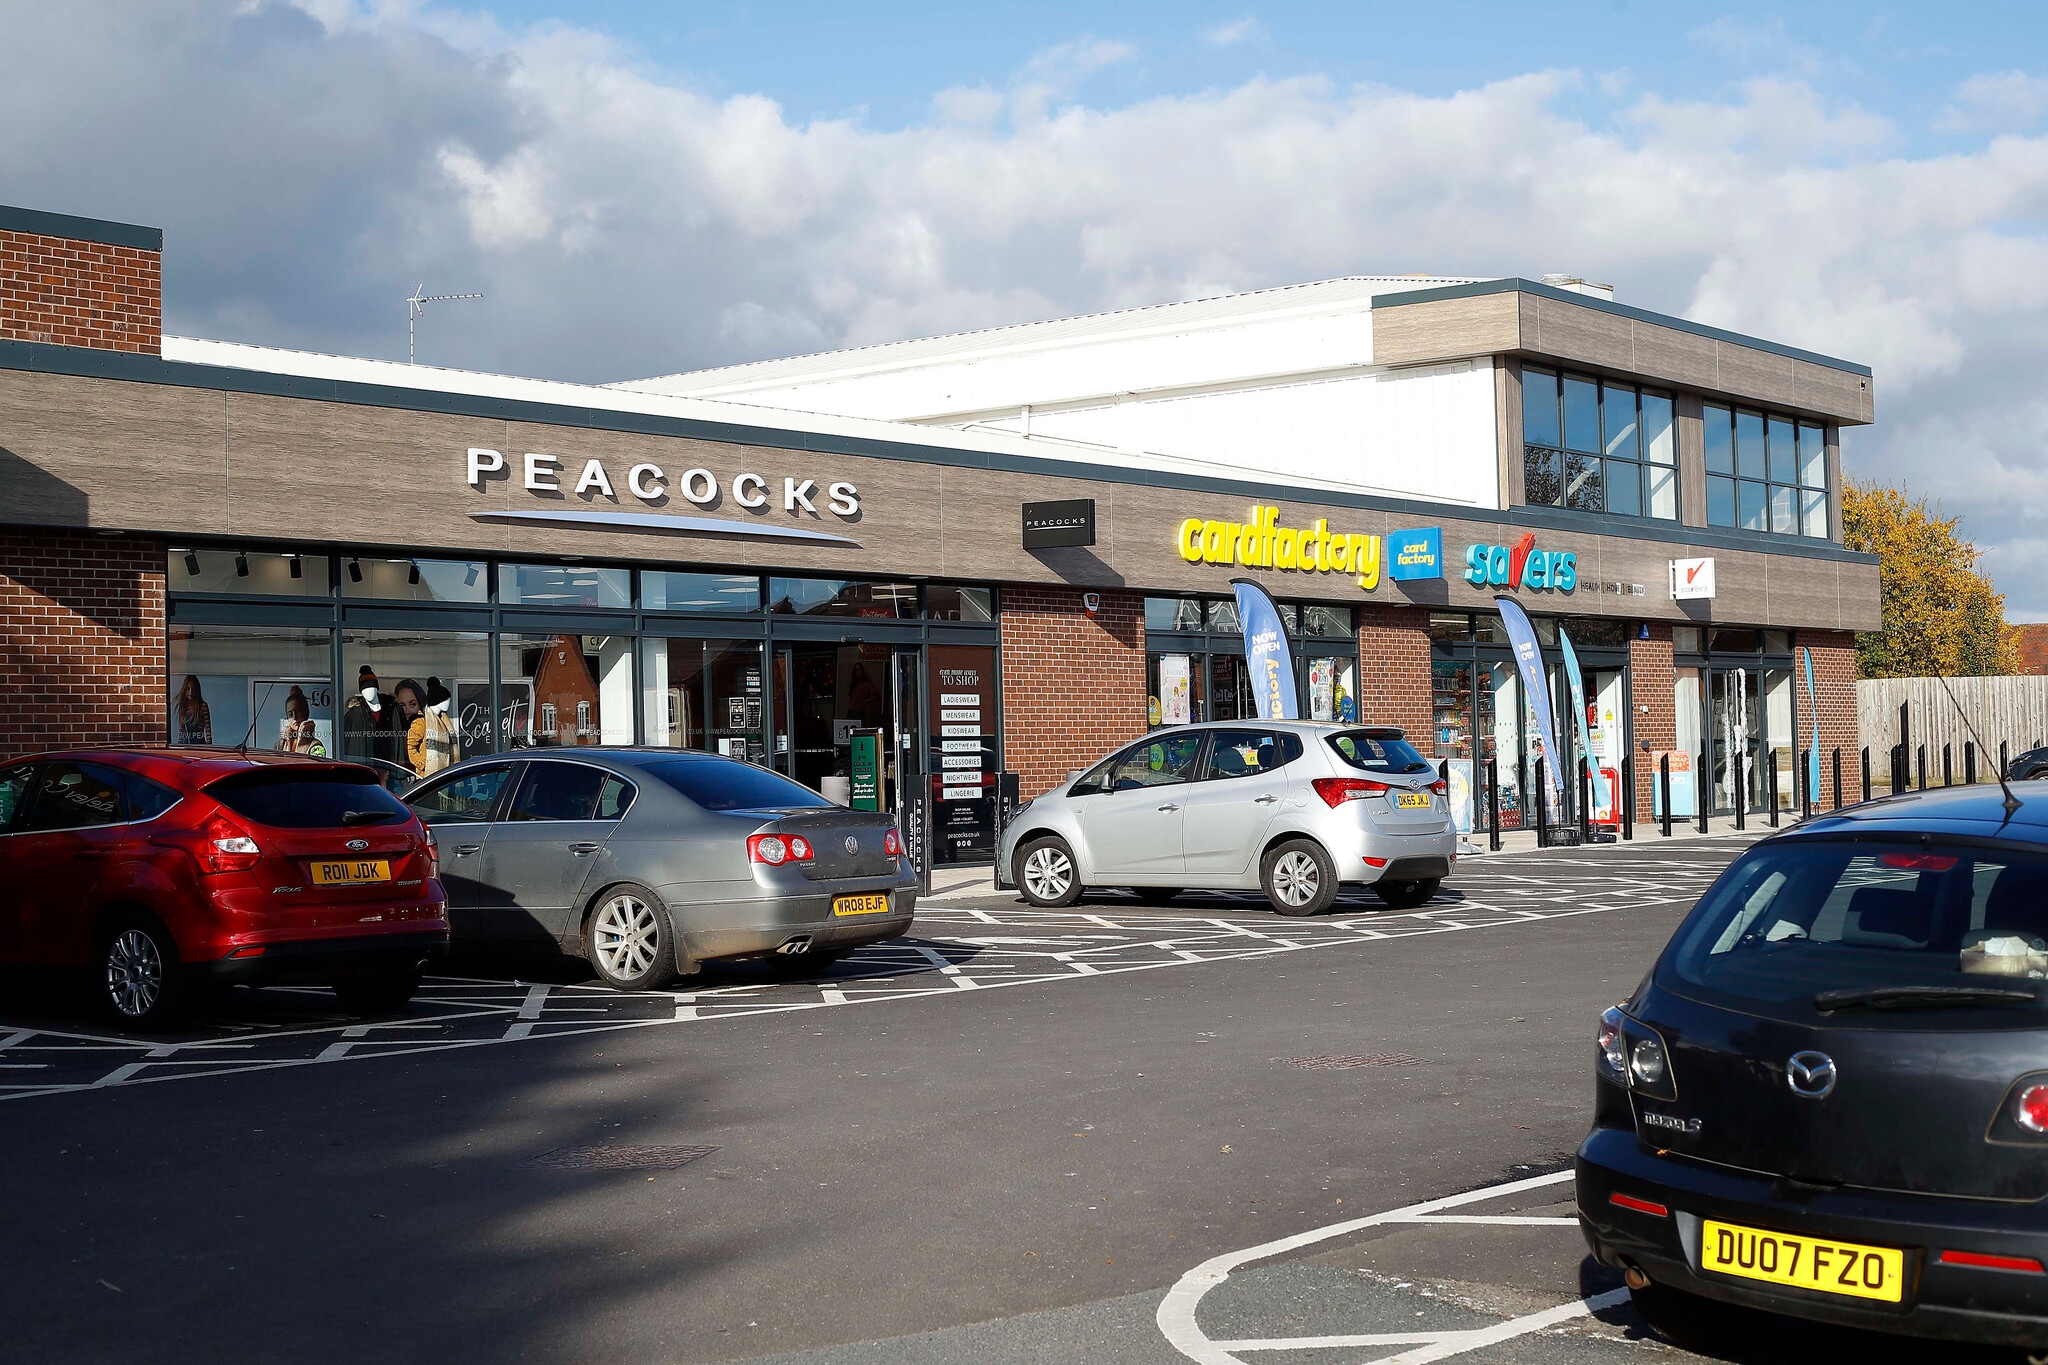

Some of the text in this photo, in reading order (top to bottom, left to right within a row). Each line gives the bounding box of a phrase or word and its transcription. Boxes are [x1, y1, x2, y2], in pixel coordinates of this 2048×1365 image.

[467, 447, 861, 517] PEACOCKS
[1026, 517, 1086, 527] PEACOCKS
[1179, 505, 1381, 590] cardfactory
[1403, 540, 1428, 553] card
[1397, 551, 1435, 566] factory
[1464, 532, 1578, 591] savers
[1251, 631, 1277, 645] NOW
[1252, 641, 1280, 655] OPEN
[941, 675, 980, 686] TO SHOP
[311, 687, 331, 707] £6
[460, 698, 529, 748] Scaett
[943, 758, 980, 766] ACCESSORIES
[1398, 794, 1429, 806] DK65 JKJ
[947, 831, 980, 840] peacocks.co.uk
[322, 862, 380, 881] RO11 JDK
[837, 896, 884, 913] WR08 EJF
[1717, 1229, 1884, 1289] DU07 FZO
